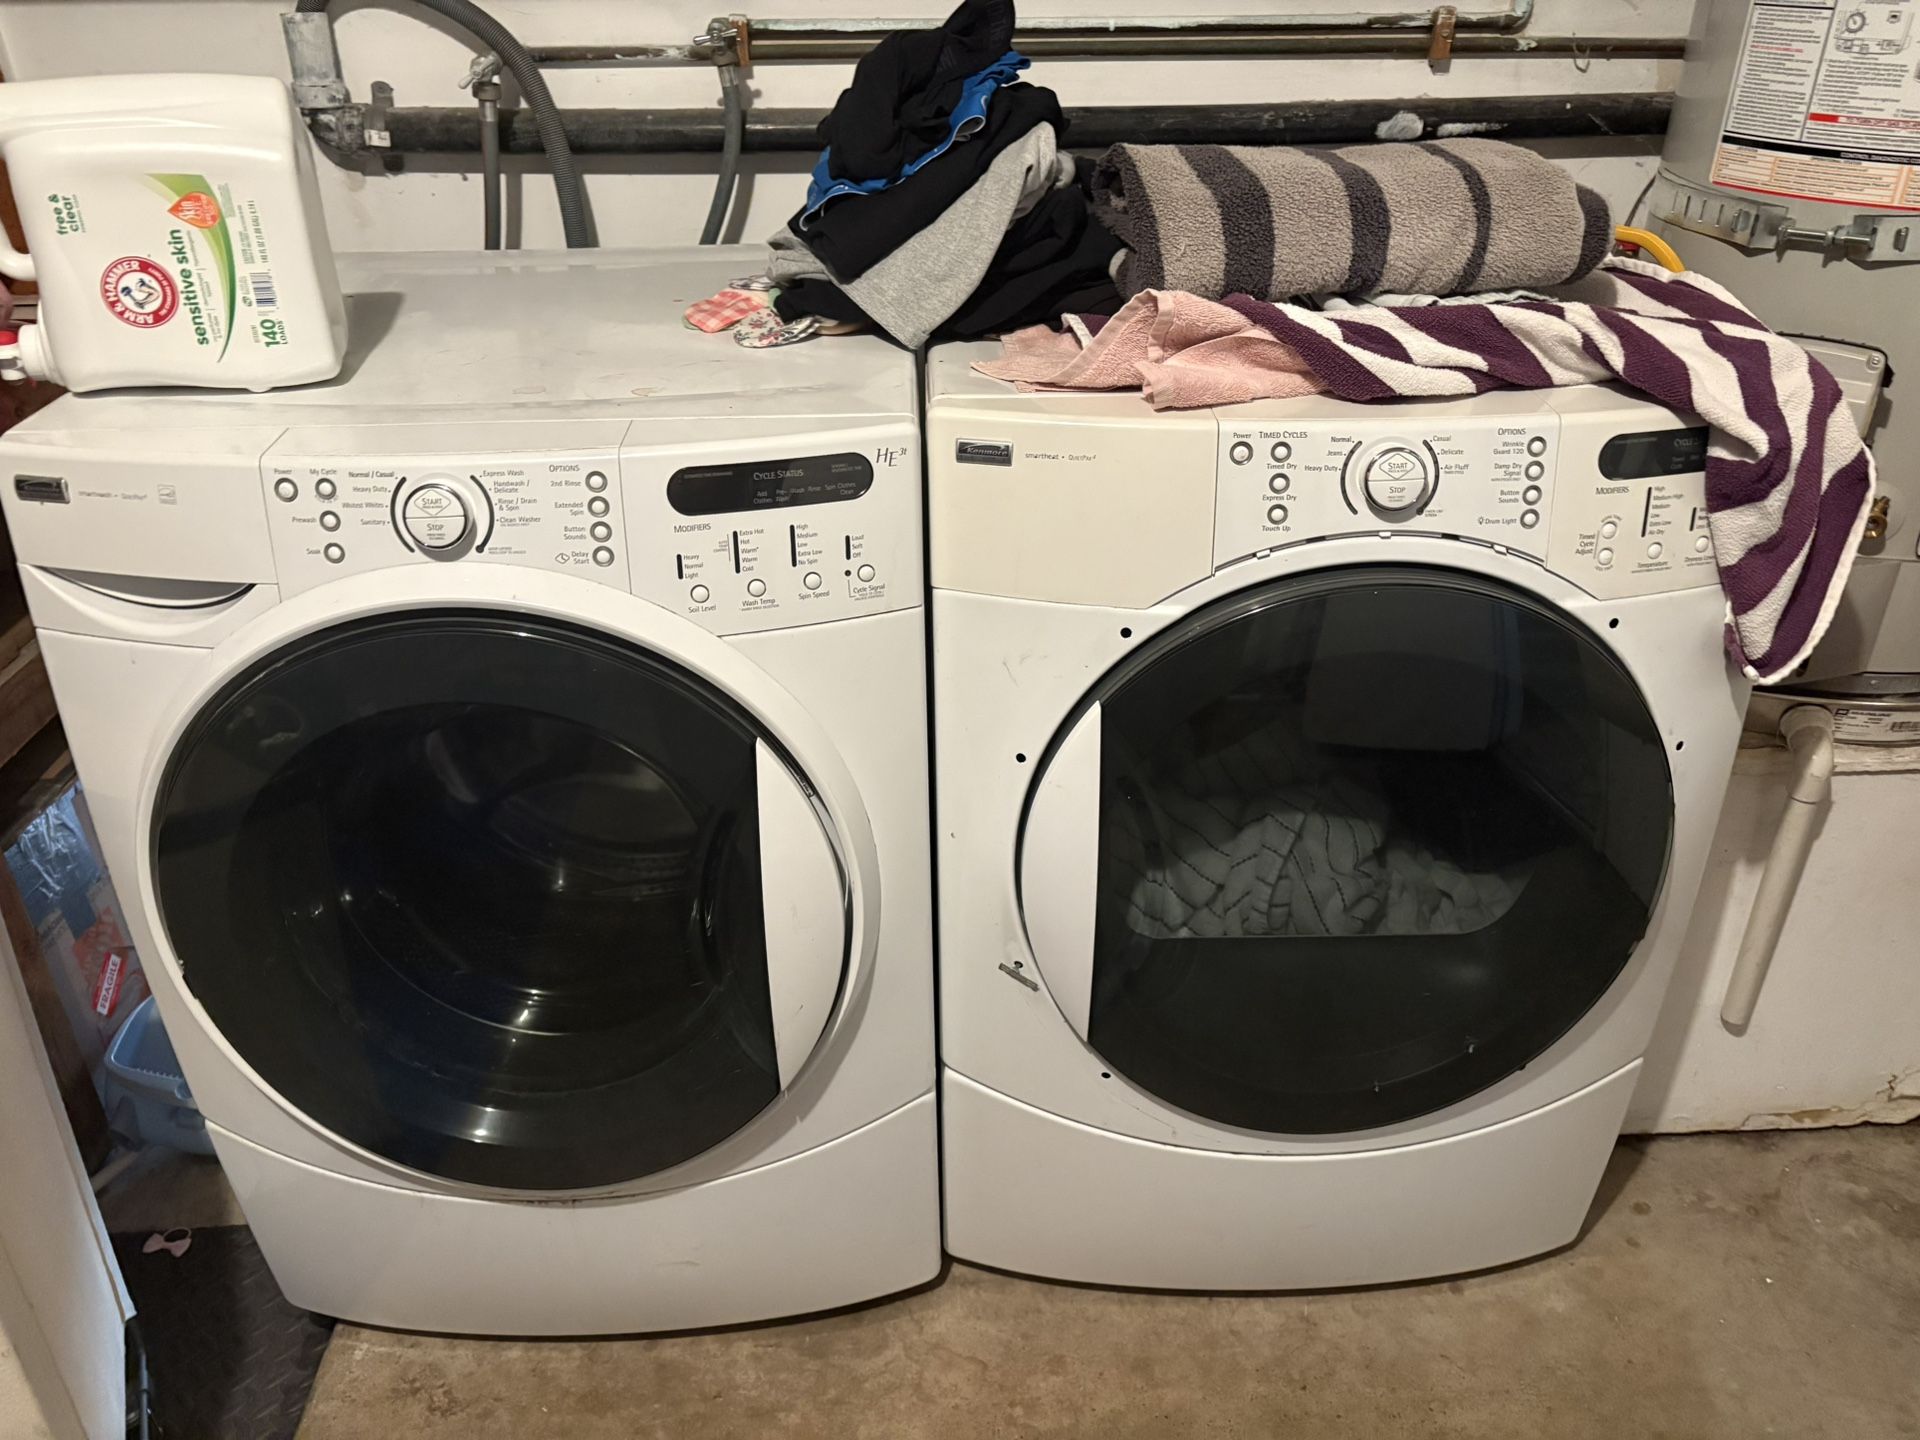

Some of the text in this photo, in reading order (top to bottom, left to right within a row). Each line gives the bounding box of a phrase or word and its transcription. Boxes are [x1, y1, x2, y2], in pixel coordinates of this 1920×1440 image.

[48, 194, 69, 236] free &
[64, 195, 80, 232] clear
[170, 229, 189, 265] skin
[104, 261, 153, 323] ARM & HAMMER
[180, 268, 209, 345] sensitive
[264, 318, 281, 347] 140
[276, 320, 289, 345] LOADS
[1259, 430, 1308, 439] TIMED CYCLES
[1497, 428, 1526, 436] OPTIONS
[967, 447, 1008, 456] Kenmore
[549, 464, 580, 472] OPTIONS
[1388, 462, 1408, 470] START
[309, 468, 337, 476] My Cycle
[483, 470, 506, 478] Express
[753, 469, 804, 481] CYCLE STATUS
[372, 485, 388, 493] Duty
[1595, 486, 1629, 495] MODIFIERS
[422, 497, 442, 506] START
[1285, 494, 1297, 502] Dry
[569, 508, 585, 516] Spin
[360, 518, 386, 526] Sanitary
[518, 515, 541, 523] Washer
[1501, 517, 1517, 525] Light
[426, 523, 444, 531] STOP
[564, 525, 586, 533] Button
[674, 523, 711, 533] MODIFIERS
[1282, 525, 1291, 533] Up
[563, 533, 587, 541] Sounds
[571, 551, 589, 559] Delay
[684, 572, 699, 580] Light
[868, 584, 886, 592] Signal
[798, 590, 830, 600] Spin Speed
[742, 598, 776, 607] Wash Temp
[688, 604, 717, 613] Soil Level
[100, 959, 119, 1009] FRAGILE
